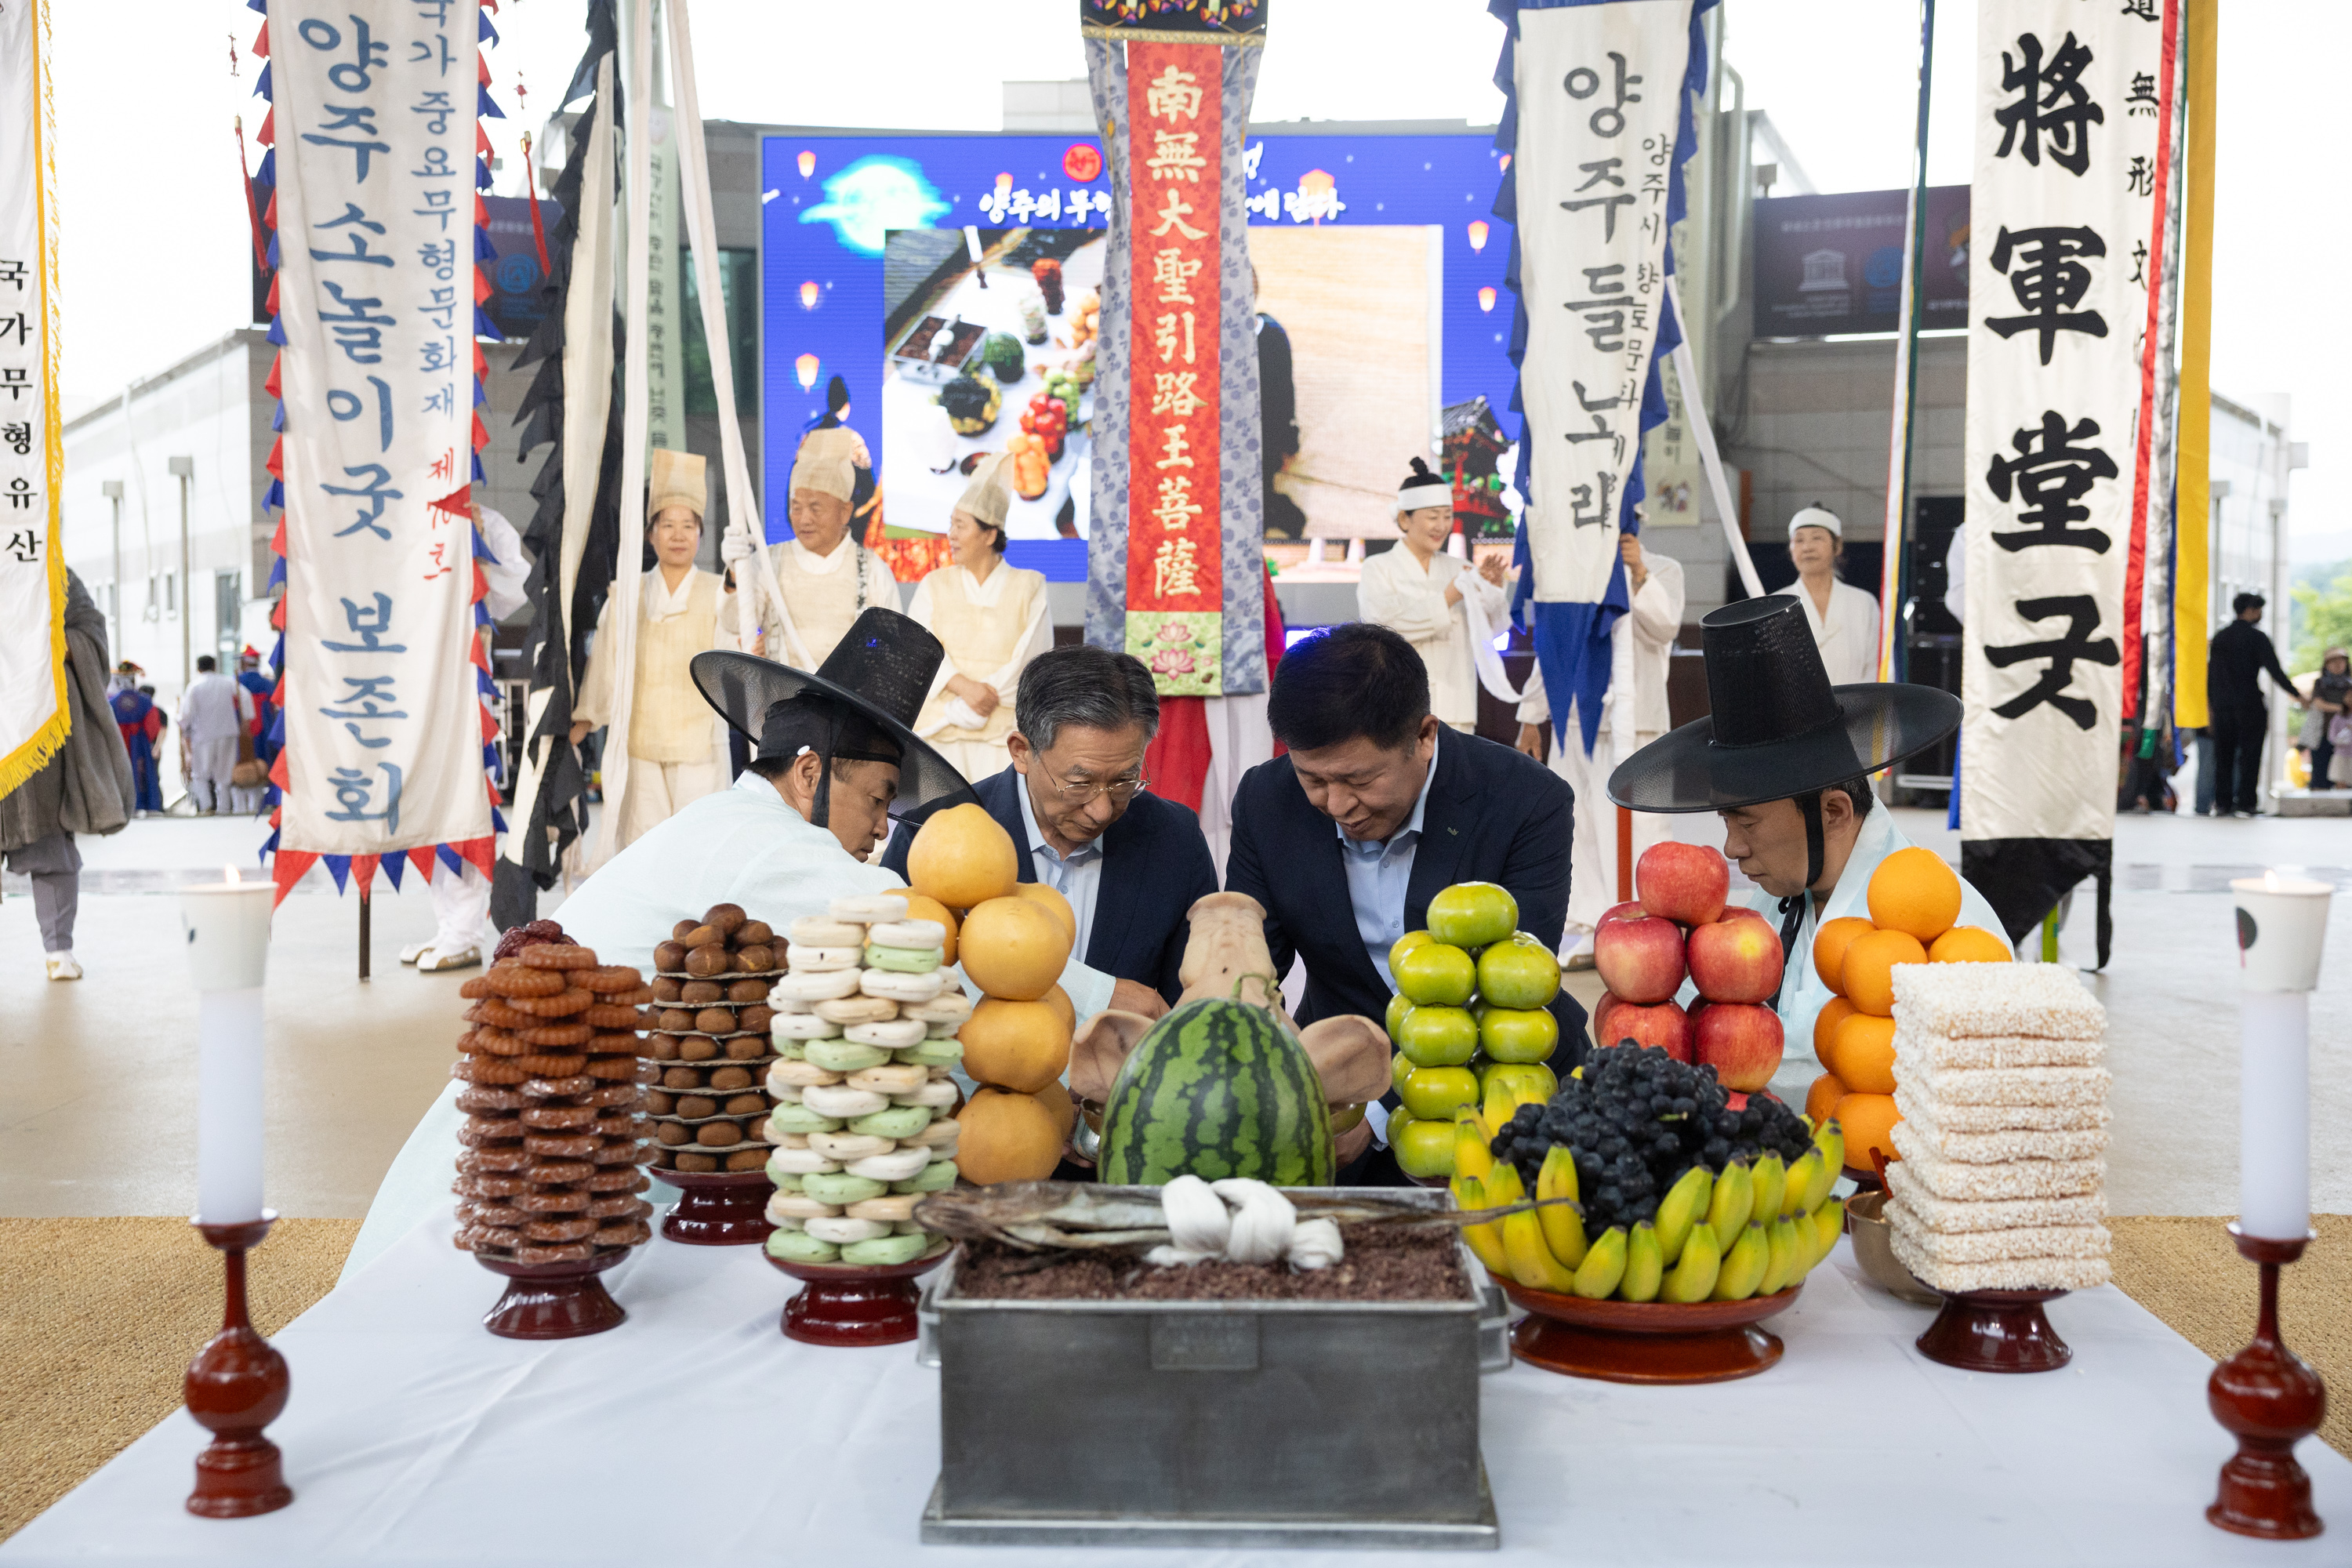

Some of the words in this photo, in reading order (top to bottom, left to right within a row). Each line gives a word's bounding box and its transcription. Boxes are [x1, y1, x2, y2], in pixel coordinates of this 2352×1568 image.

[298, 14, 404, 541] 양주소놀이굿
[979, 185, 1062, 224] 양주의
[1641, 133, 1673, 245] 양주시
[0, 260, 42, 562] 국가무형유산
[1145, 64, 1209, 600] 南無大聖引路王菩薩
[320, 591, 408, 837] 보존회
